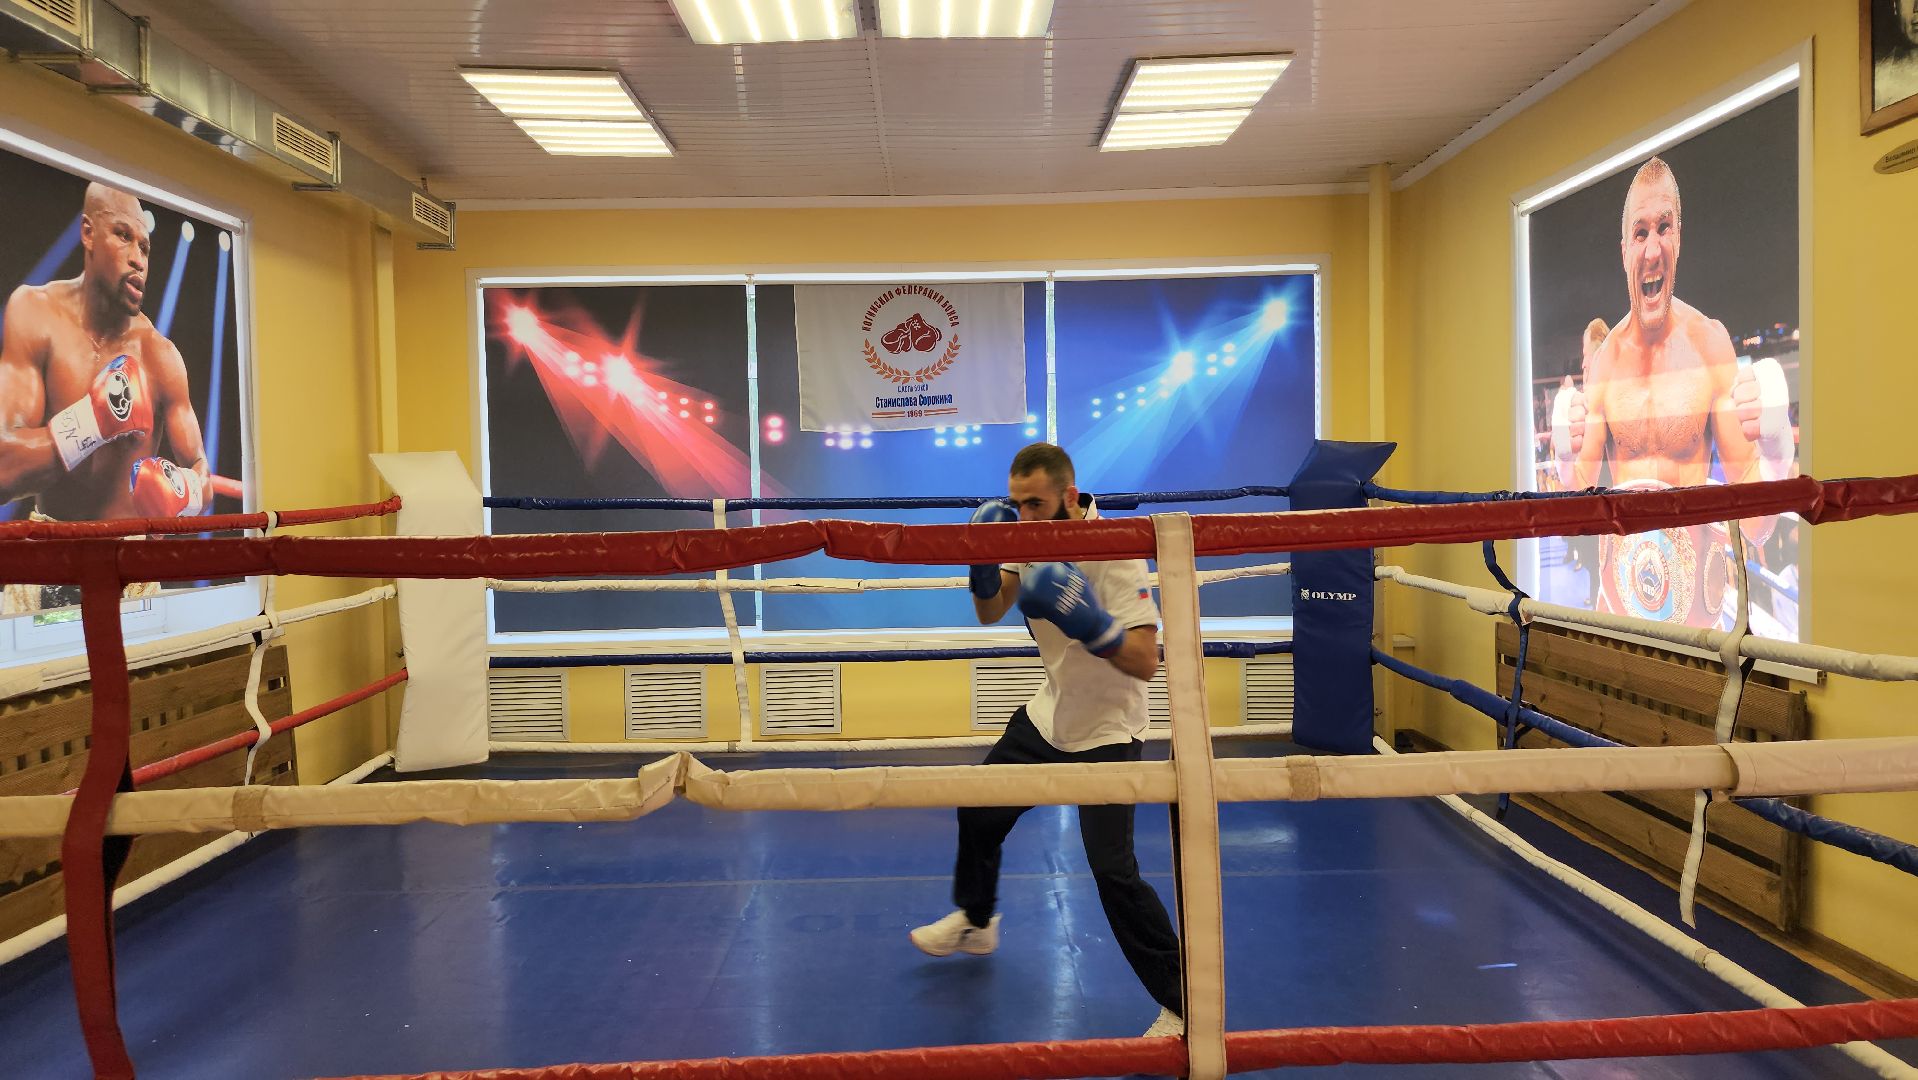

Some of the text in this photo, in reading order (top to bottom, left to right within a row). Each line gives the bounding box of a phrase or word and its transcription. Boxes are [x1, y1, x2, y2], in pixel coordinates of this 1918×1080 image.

[895, 284, 944, 304] ФЕДЕРАЦИЯ
[941, 300, 960, 328] БОКСА
[875, 393, 953, 409] Станислава Сорокина
[906, 409, 923, 418] 1969
[1311, 591, 1357, 601] OLYMP
